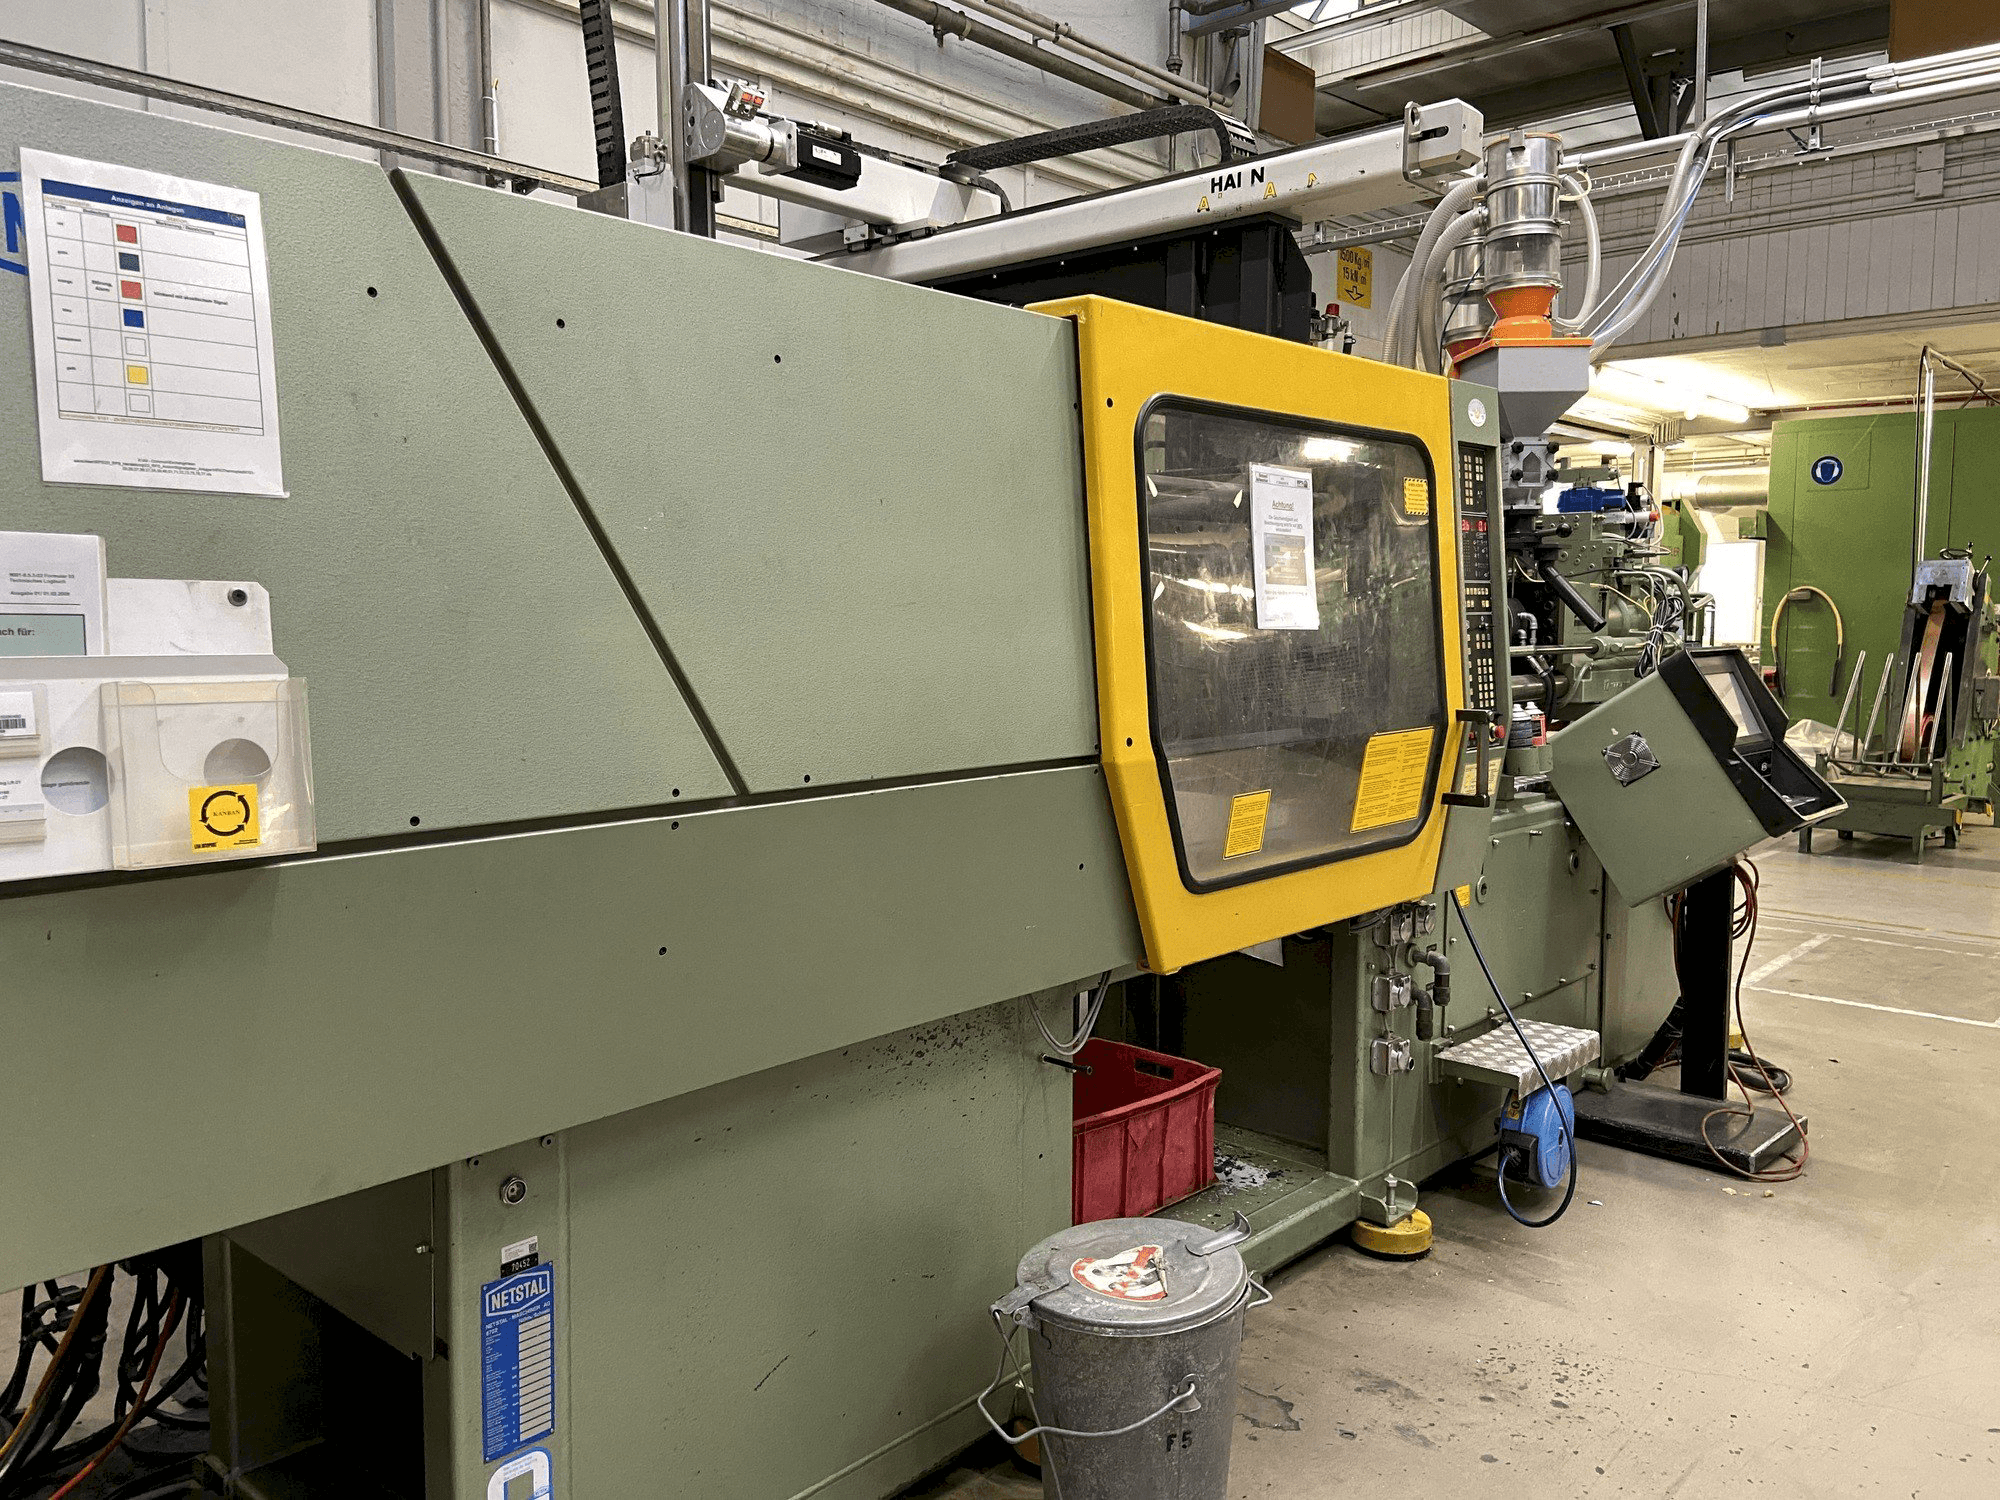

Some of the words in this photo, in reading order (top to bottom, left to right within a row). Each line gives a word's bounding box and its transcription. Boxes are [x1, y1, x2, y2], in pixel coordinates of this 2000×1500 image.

[111, 195, 145, 207] Anzeigen
[156, 203, 185, 214] Anlagen
[1272, 500, 1294, 511] Achtung!
[17, 628, 35, 636] für:
[491, 1277, 546, 1311] NETSTAL
